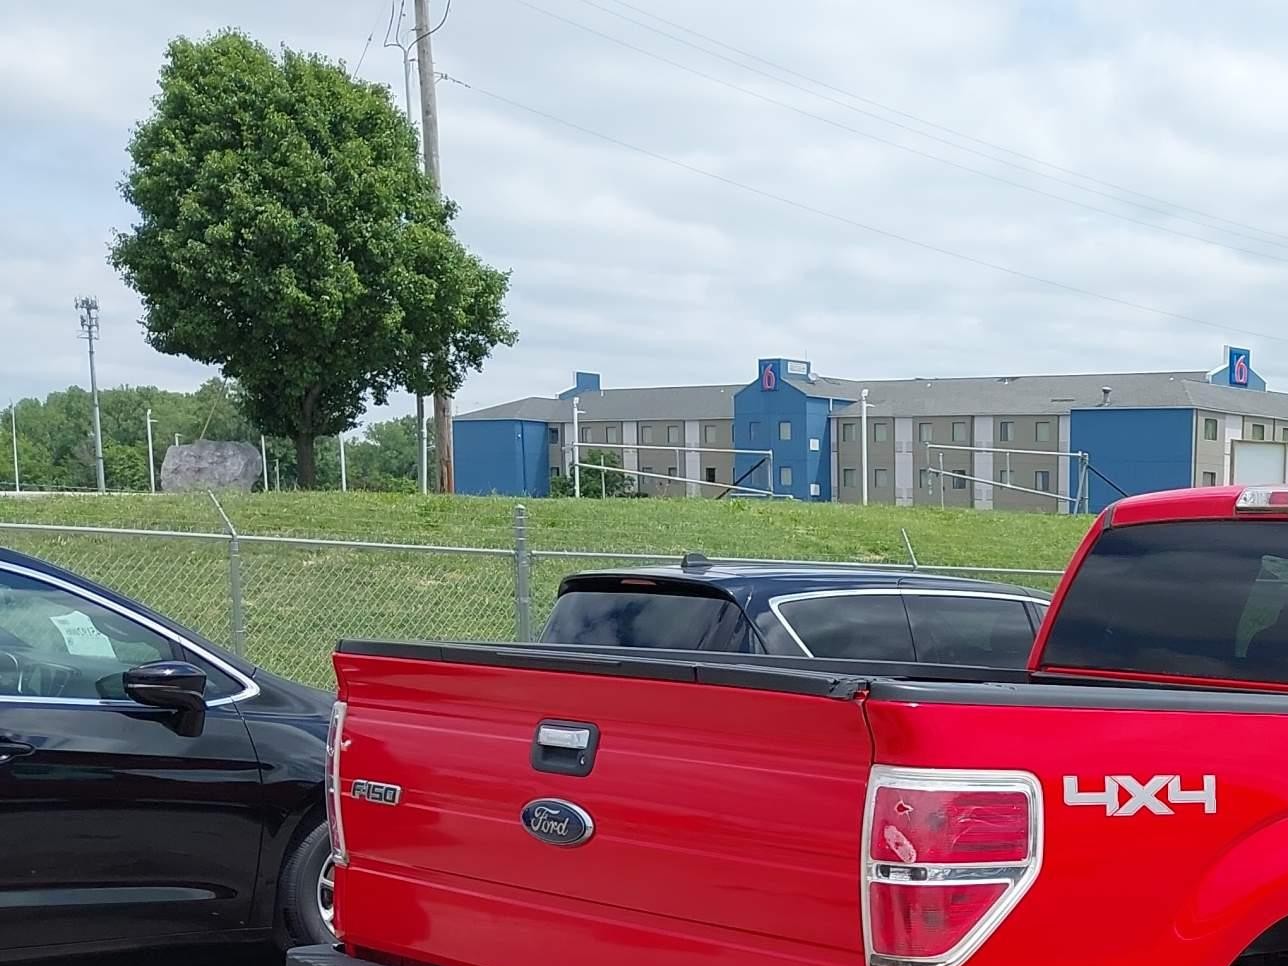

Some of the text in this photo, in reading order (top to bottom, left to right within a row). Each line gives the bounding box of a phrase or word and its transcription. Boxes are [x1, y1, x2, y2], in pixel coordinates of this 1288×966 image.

[763, 363, 776, 390] 6
[1234, 354, 1248, 385] 6
[530, 806, 570, 836] Ford
